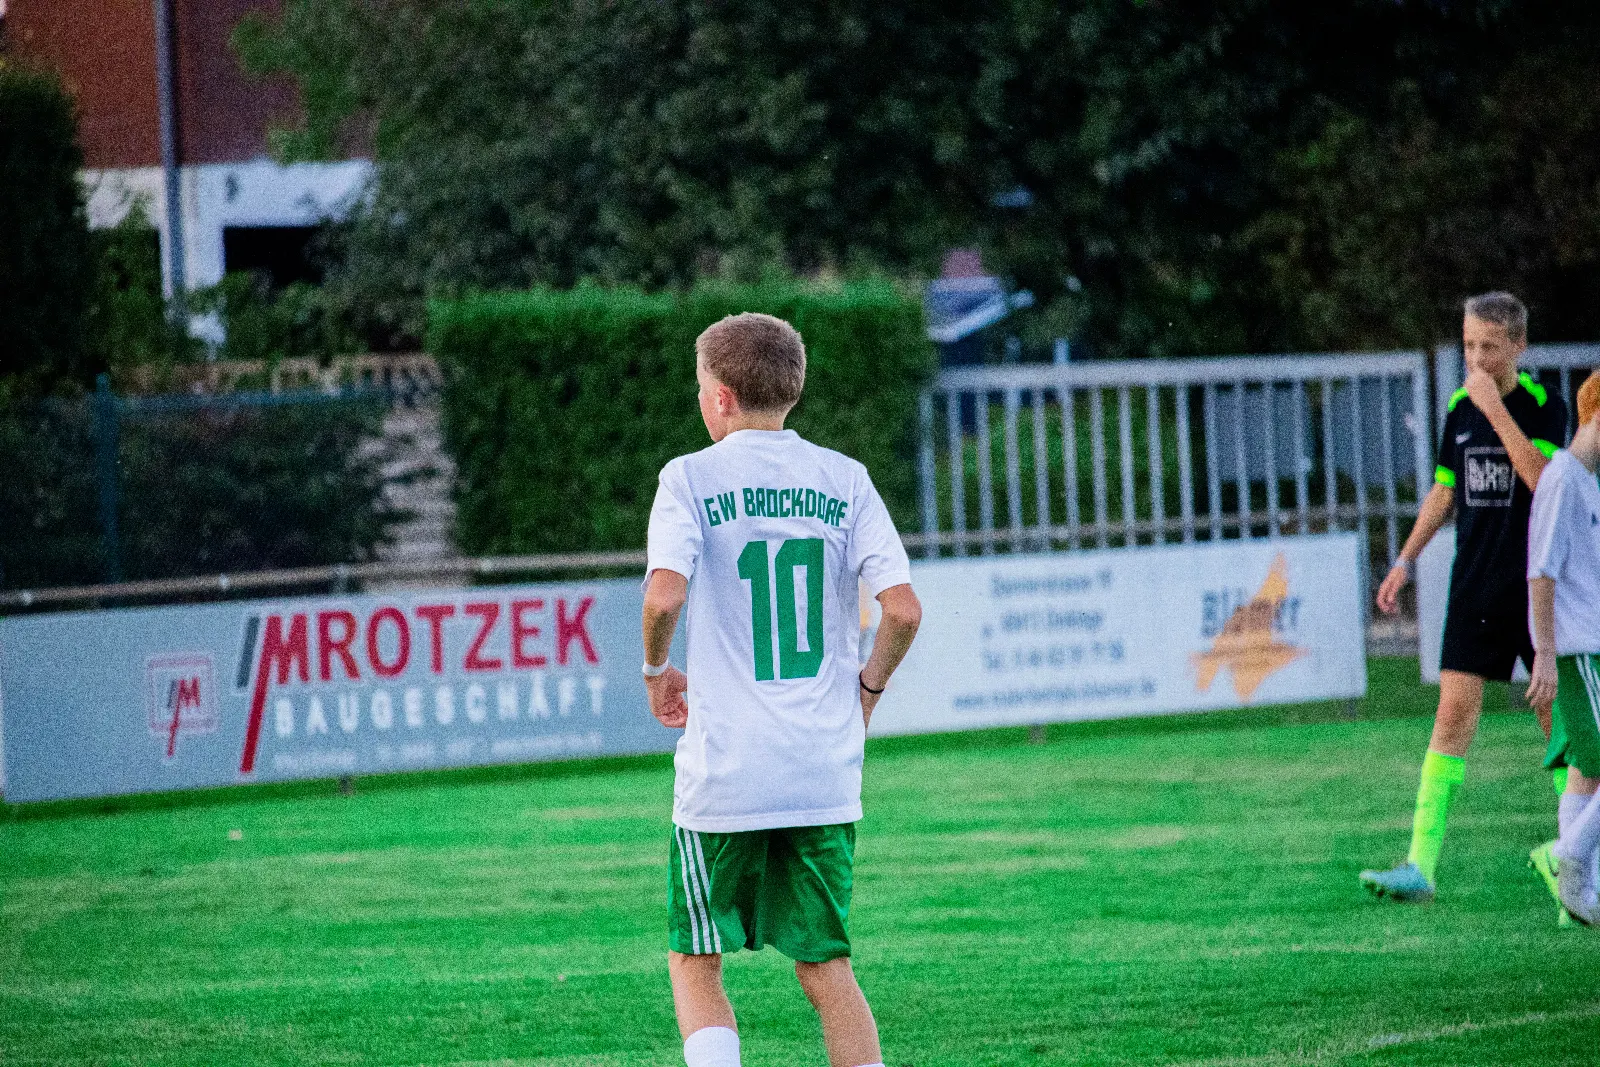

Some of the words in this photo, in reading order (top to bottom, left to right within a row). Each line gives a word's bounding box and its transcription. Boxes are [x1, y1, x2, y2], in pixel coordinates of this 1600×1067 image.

[704, 491, 737, 527] GW
[742, 487, 848, 527] BROCKDORF
[737, 537, 825, 682] 10
[274, 673, 606, 738] BAUGESCHÄFT
